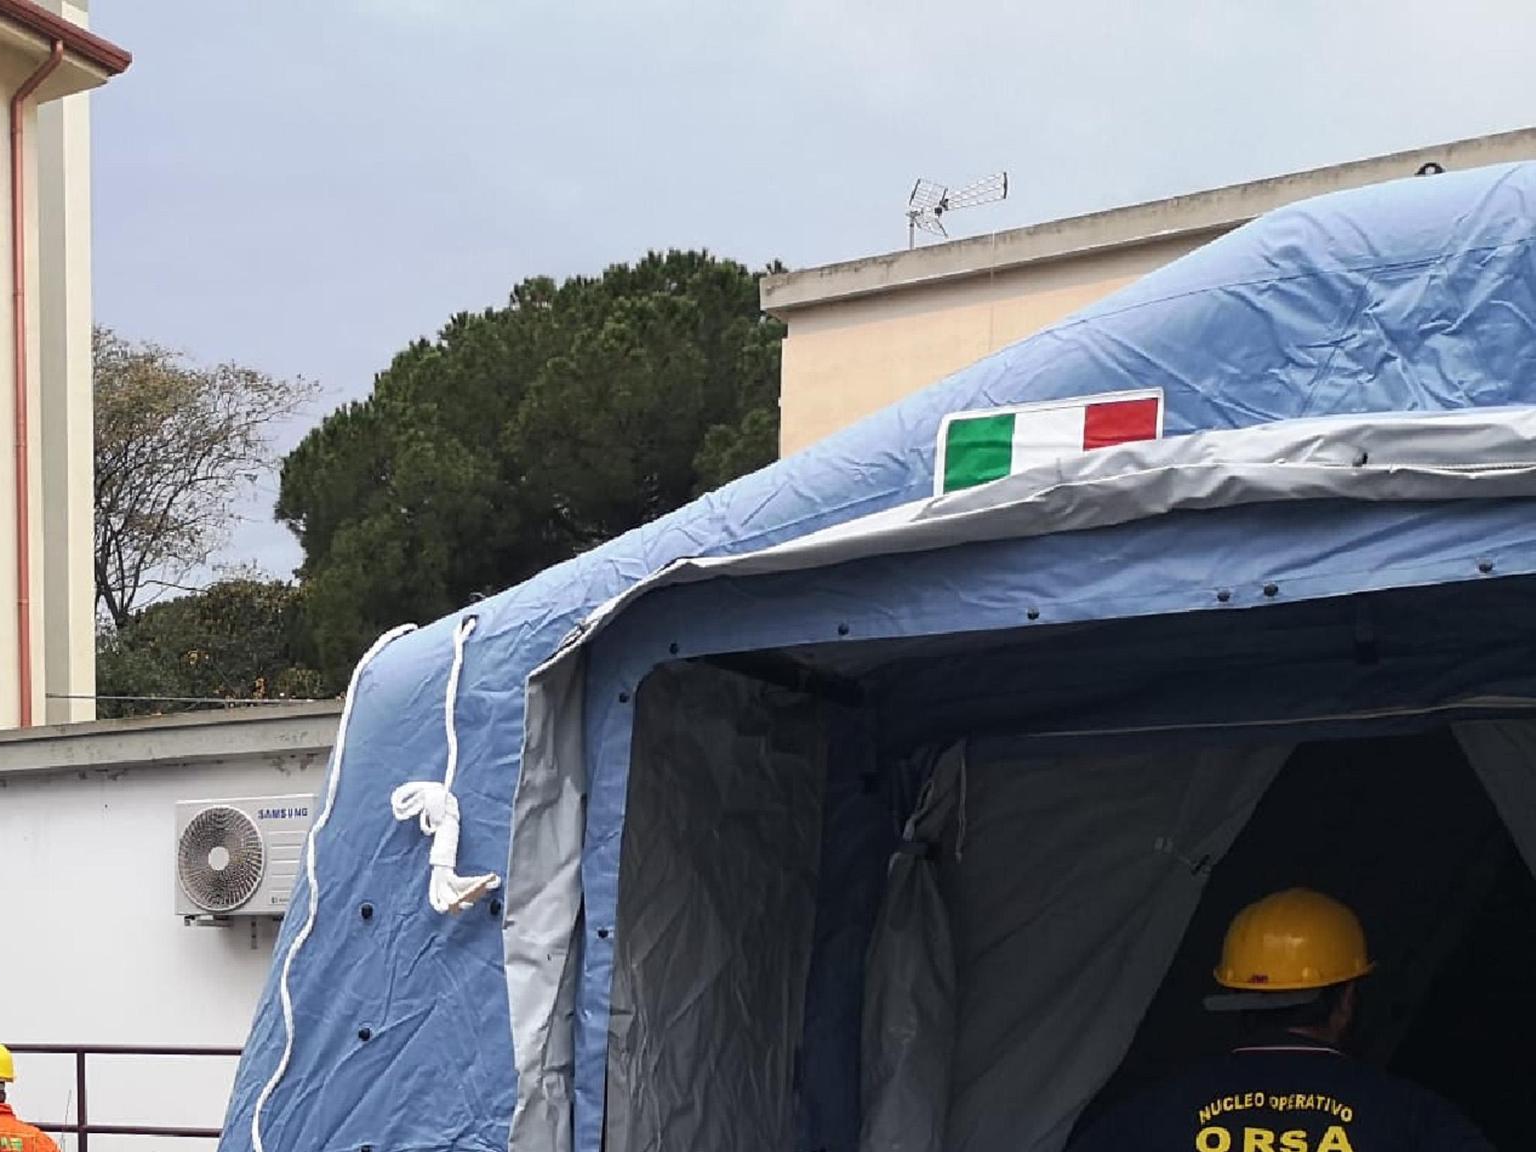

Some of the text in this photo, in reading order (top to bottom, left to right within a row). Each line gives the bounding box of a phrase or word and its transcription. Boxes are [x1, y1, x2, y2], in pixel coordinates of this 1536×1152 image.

[258, 807, 308, 820] SAMSUNG
[1199, 1092, 1353, 1124] NUCLEO OPERATIVO
